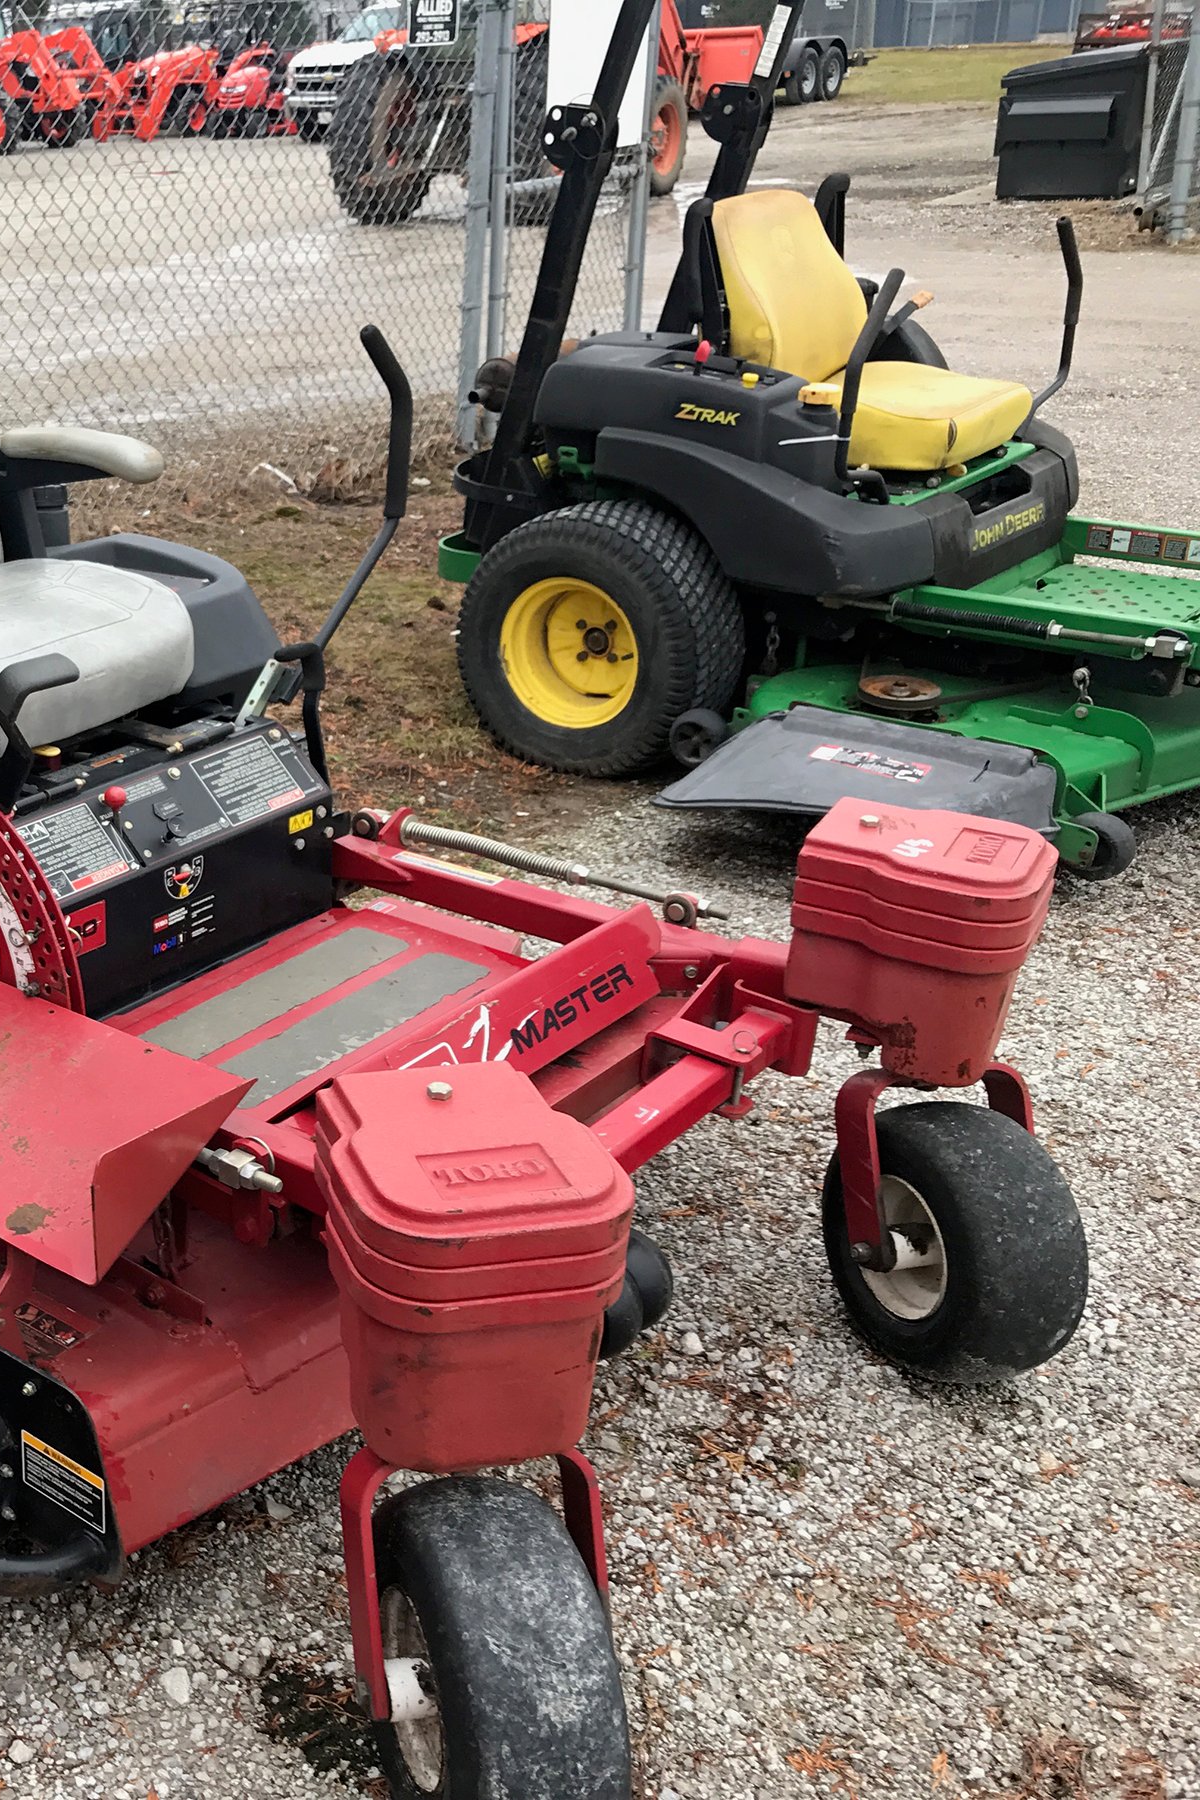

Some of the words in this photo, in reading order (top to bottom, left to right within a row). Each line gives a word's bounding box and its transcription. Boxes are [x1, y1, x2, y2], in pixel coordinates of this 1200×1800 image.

[415, 0, 454, 17] ALLIED
[674, 403, 741, 426] ZTRAK
[972, 521, 1004, 552] JOHN
[510, 963, 635, 1055] MASTER
[432, 1158, 548, 1188] TORO
